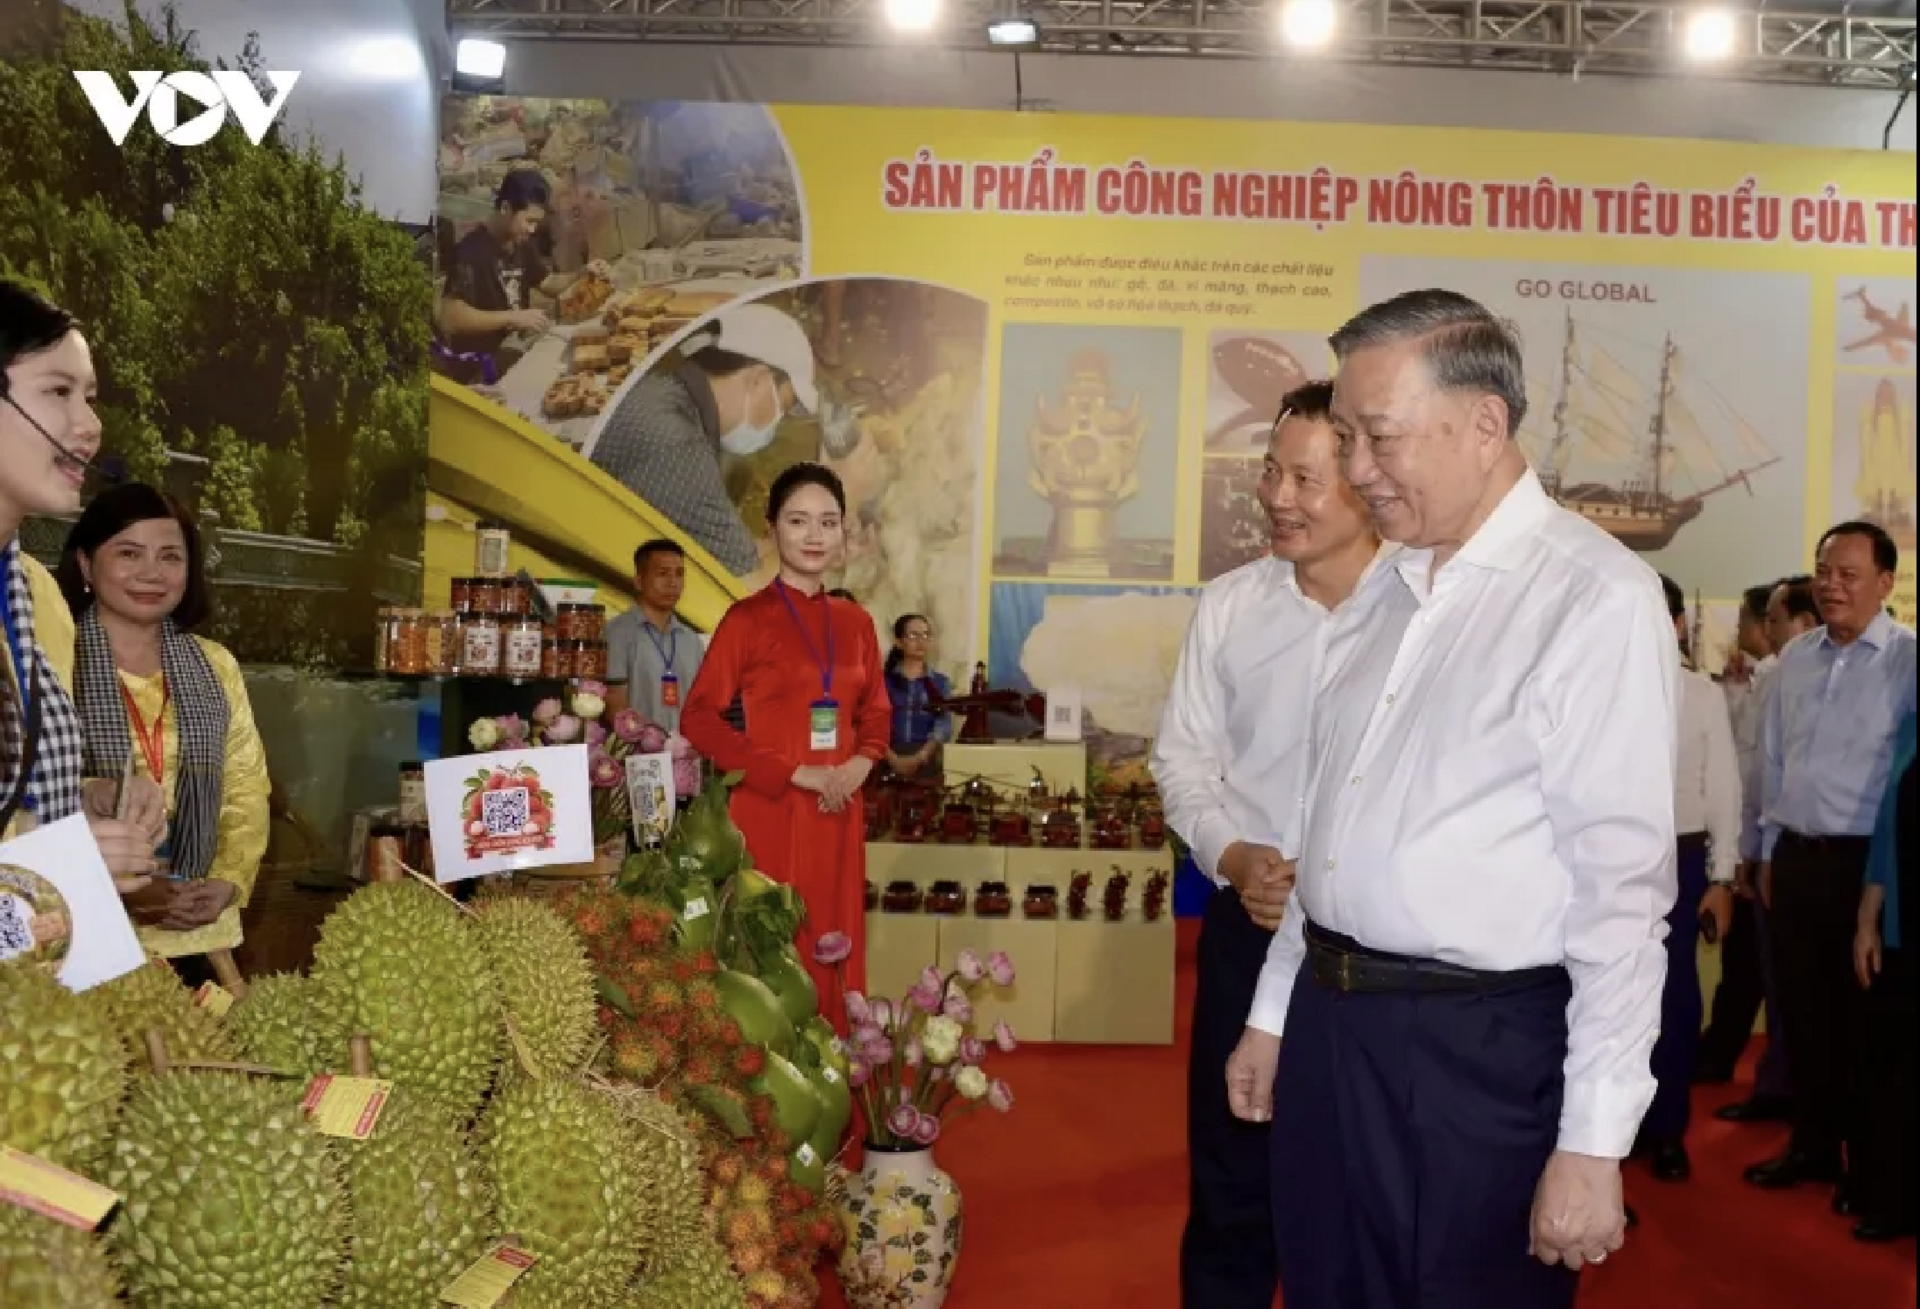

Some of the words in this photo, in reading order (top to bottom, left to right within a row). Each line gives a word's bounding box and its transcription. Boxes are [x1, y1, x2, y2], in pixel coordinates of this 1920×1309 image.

[884, 148, 963, 210] SẢN
[973, 148, 1086, 212] PHẨM
[1096, 161, 1202, 216] CÔNG
[1213, 167, 1358, 231] NGHIỆP
[1367, 171, 1472, 227] NÔNG
[1483, 177, 1582, 233] THÔN
[1593, 182, 1679, 237] TIÊU
[1690, 177, 1780, 241] BIỂU
[1791, 186, 1867, 244] CỦA
[1875, 202, 1917, 246] TH
[1516, 280, 1552, 299] GO
[1559, 281, 1657, 304] GLOBAL
